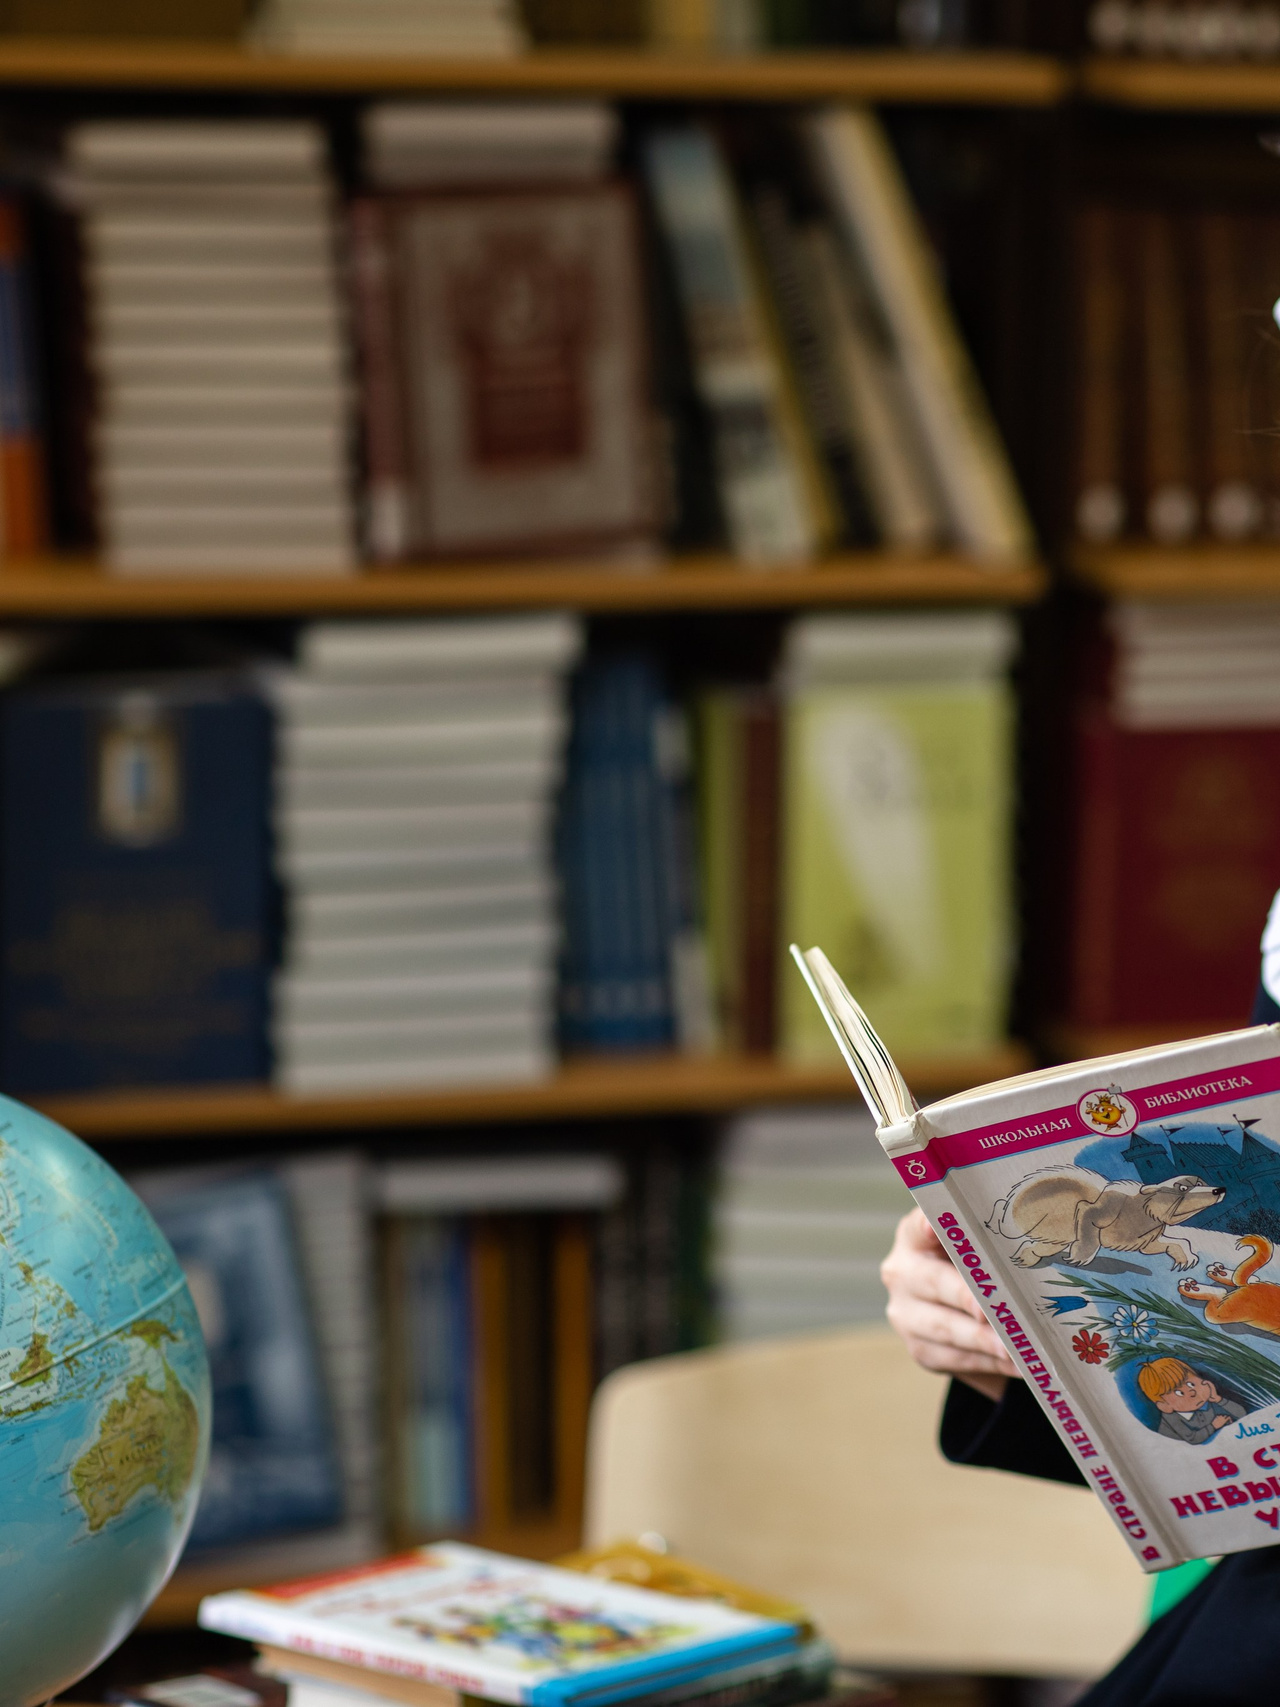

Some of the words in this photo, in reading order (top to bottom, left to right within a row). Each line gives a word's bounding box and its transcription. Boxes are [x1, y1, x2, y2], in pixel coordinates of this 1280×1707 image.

[978, 1117, 1072, 1150] ШКОЛЬНАЯ
[1143, 1075, 1254, 1109] БИБЛИОТЕКА
[937, 1211, 998, 1298] УРОКОВ
[990, 1301, 1100, 1460] НЕВЫУЧЕННЫХ
[1205, 1455, 1240, 1481] В
[1234, 1422, 1275, 1440] Лия
[1090, 1464, 1147, 1540] СТРАНЕ
[1141, 1545, 1162, 1562] В
